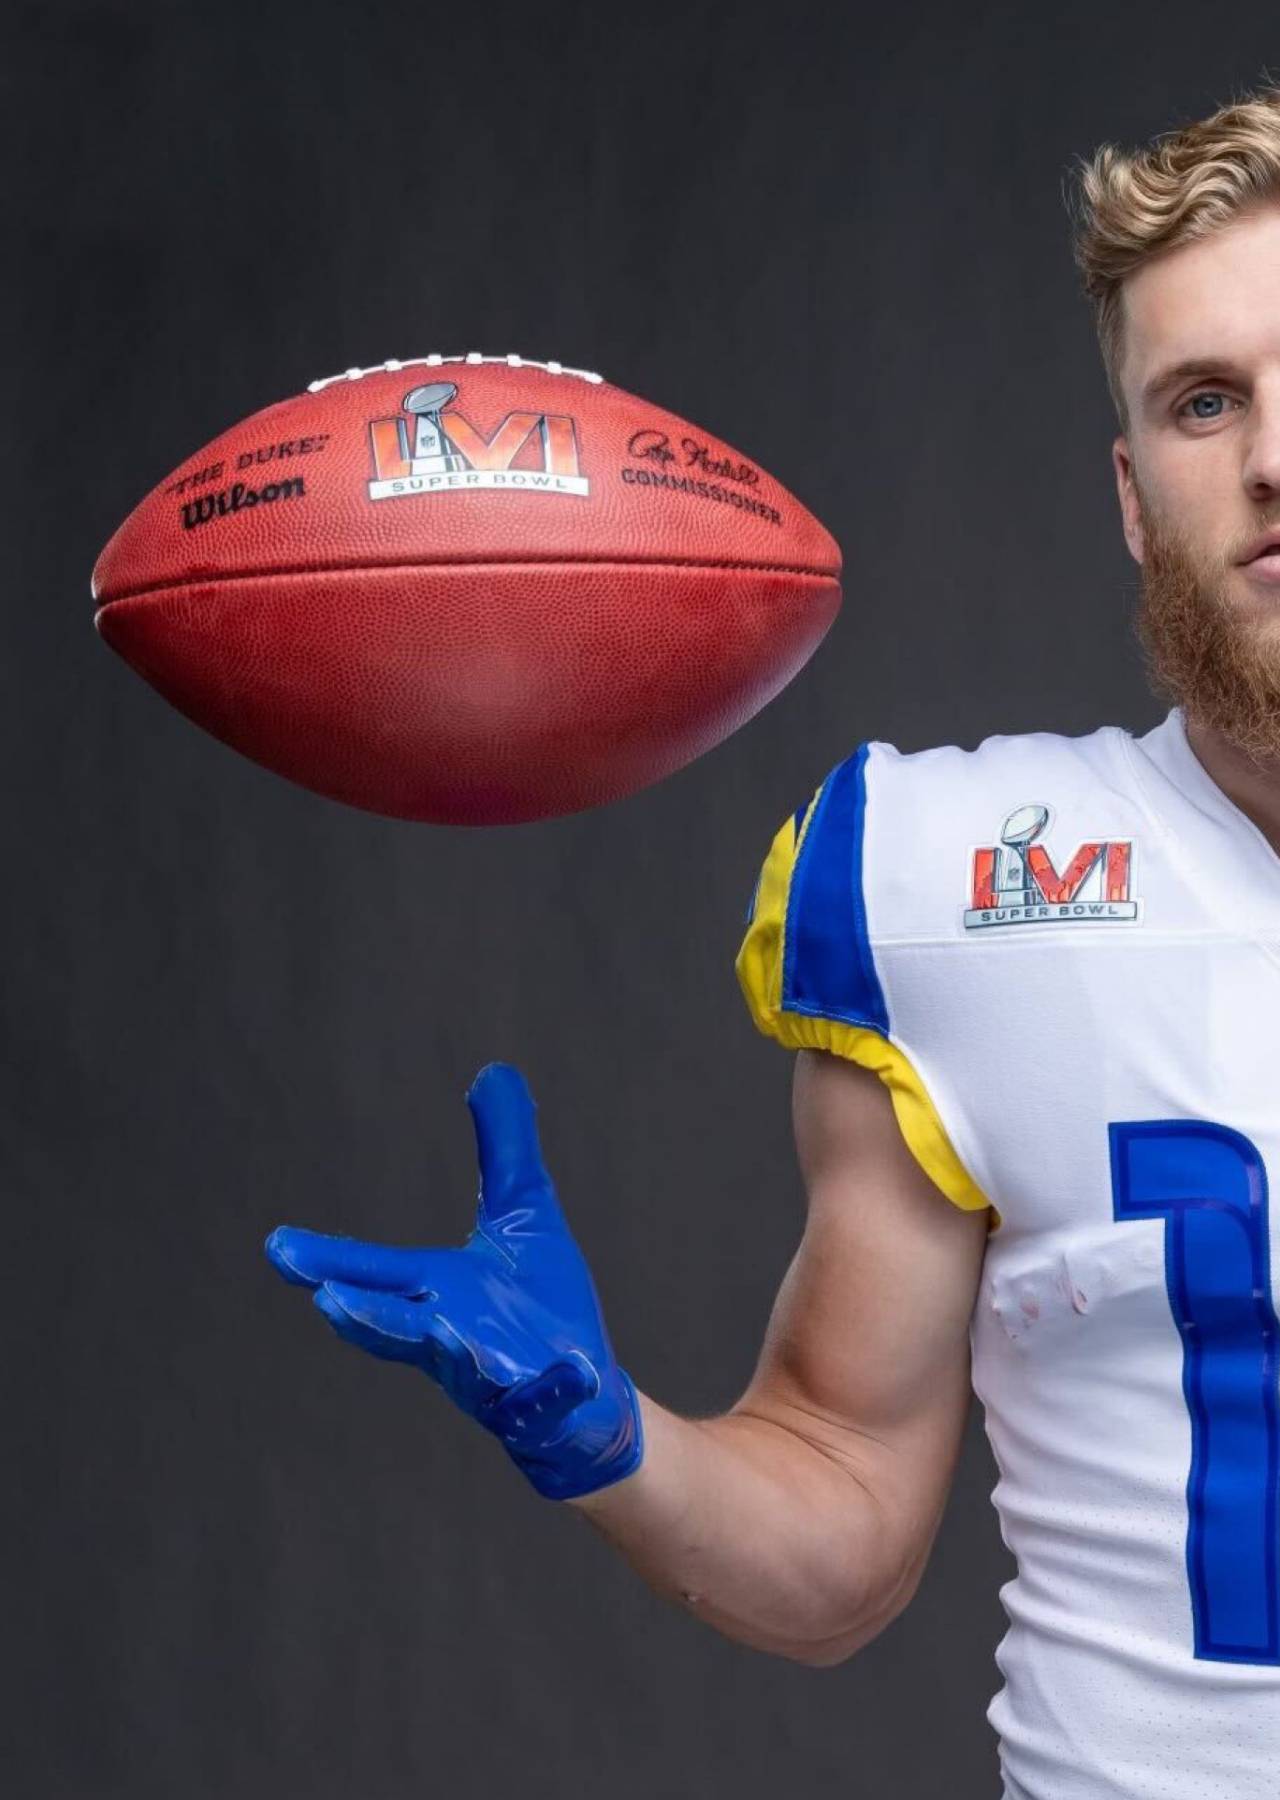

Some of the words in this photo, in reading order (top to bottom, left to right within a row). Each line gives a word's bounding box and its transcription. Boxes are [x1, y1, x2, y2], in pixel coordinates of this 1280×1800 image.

[392, 474, 479, 493] SUPER
[494, 473, 569, 489] BOWL
[622, 468, 783, 526] COMMISSIONER
[181, 476, 306, 530] Wilson
[981, 906, 1049, 922] SUPER
[1059, 904, 1118, 916] BOWL
